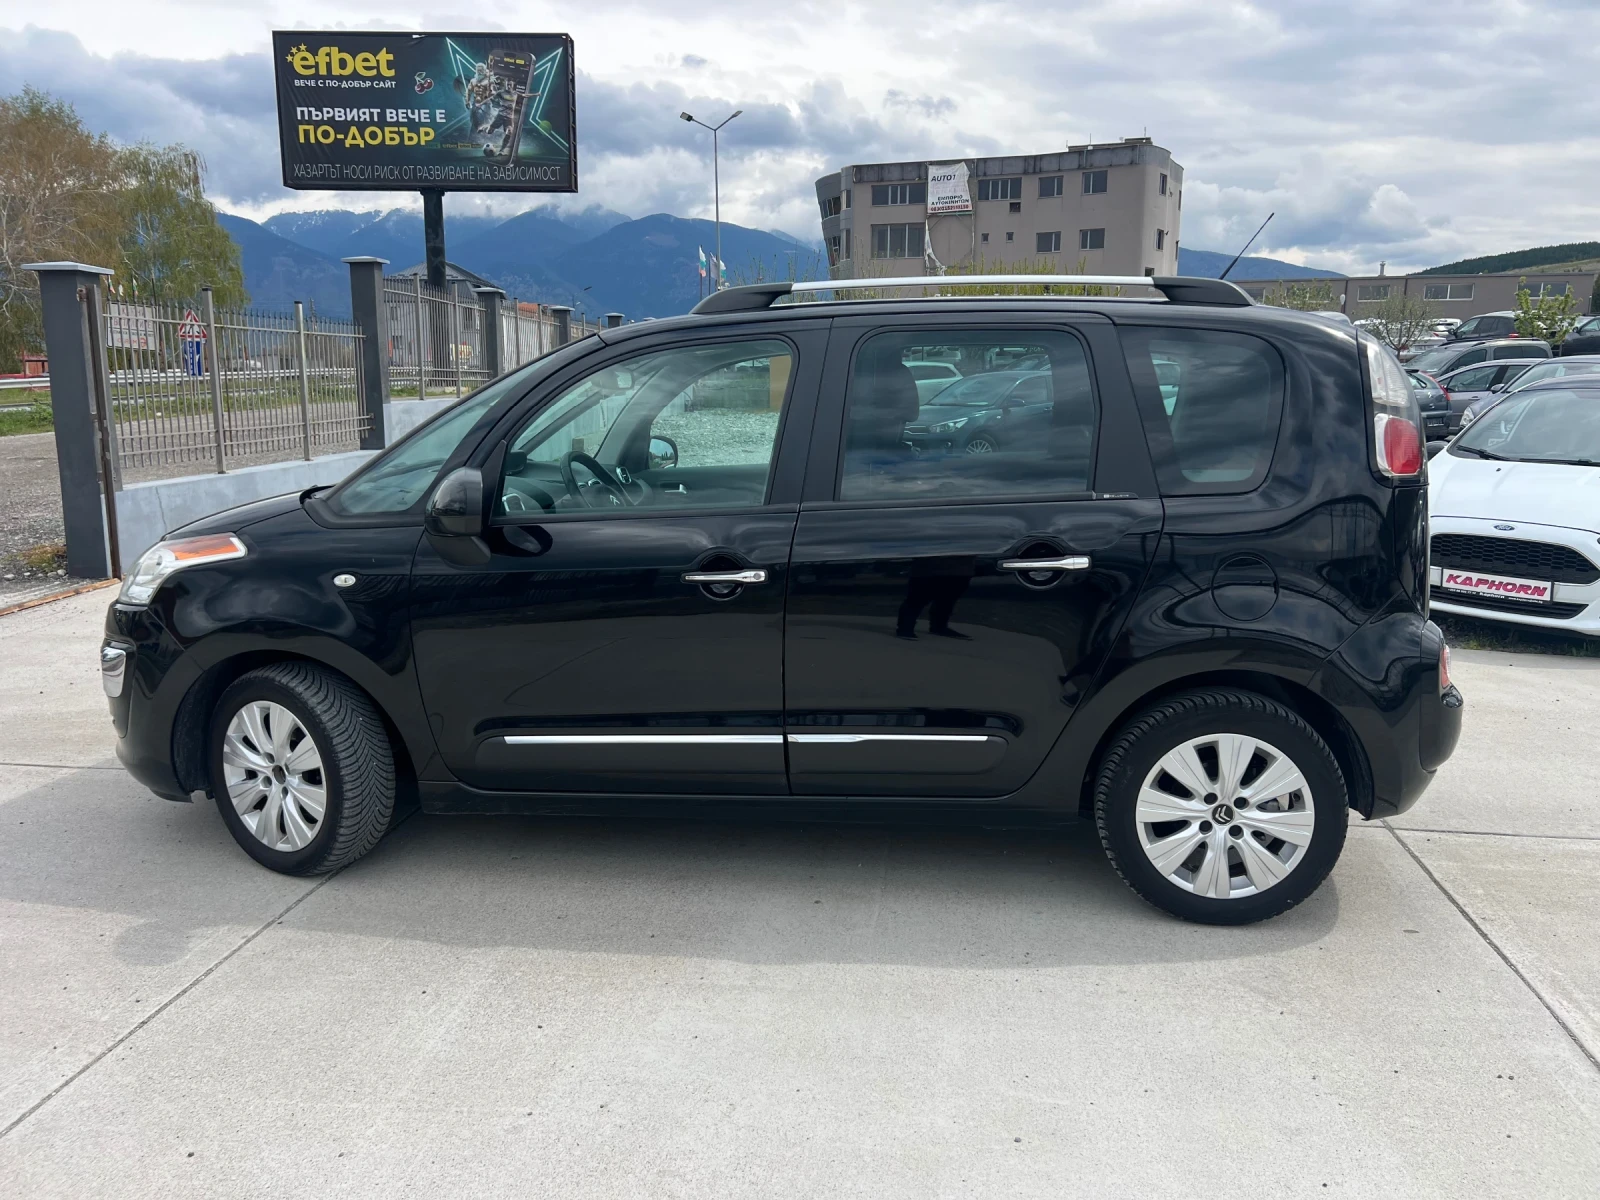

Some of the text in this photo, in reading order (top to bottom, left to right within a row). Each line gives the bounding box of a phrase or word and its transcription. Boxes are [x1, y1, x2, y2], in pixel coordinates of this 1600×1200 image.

[293, 46, 395, 77] efbet
[294, 79, 396, 89] ВЕЧЕ С ПО-ДОБЪР САЙТ
[296, 107, 447, 123] ПЪРВИЯТ ВЕЧЕ Е
[298, 124, 435, 148] ПО-ДОБЪР
[293, 163, 561, 180] ХАЗАРТЪТ НОСИ РИСК ОТ РАЗВИВАНЕ НА ЗАВИСИМОСТ
[1445, 573, 1548, 597] KAPHORN
